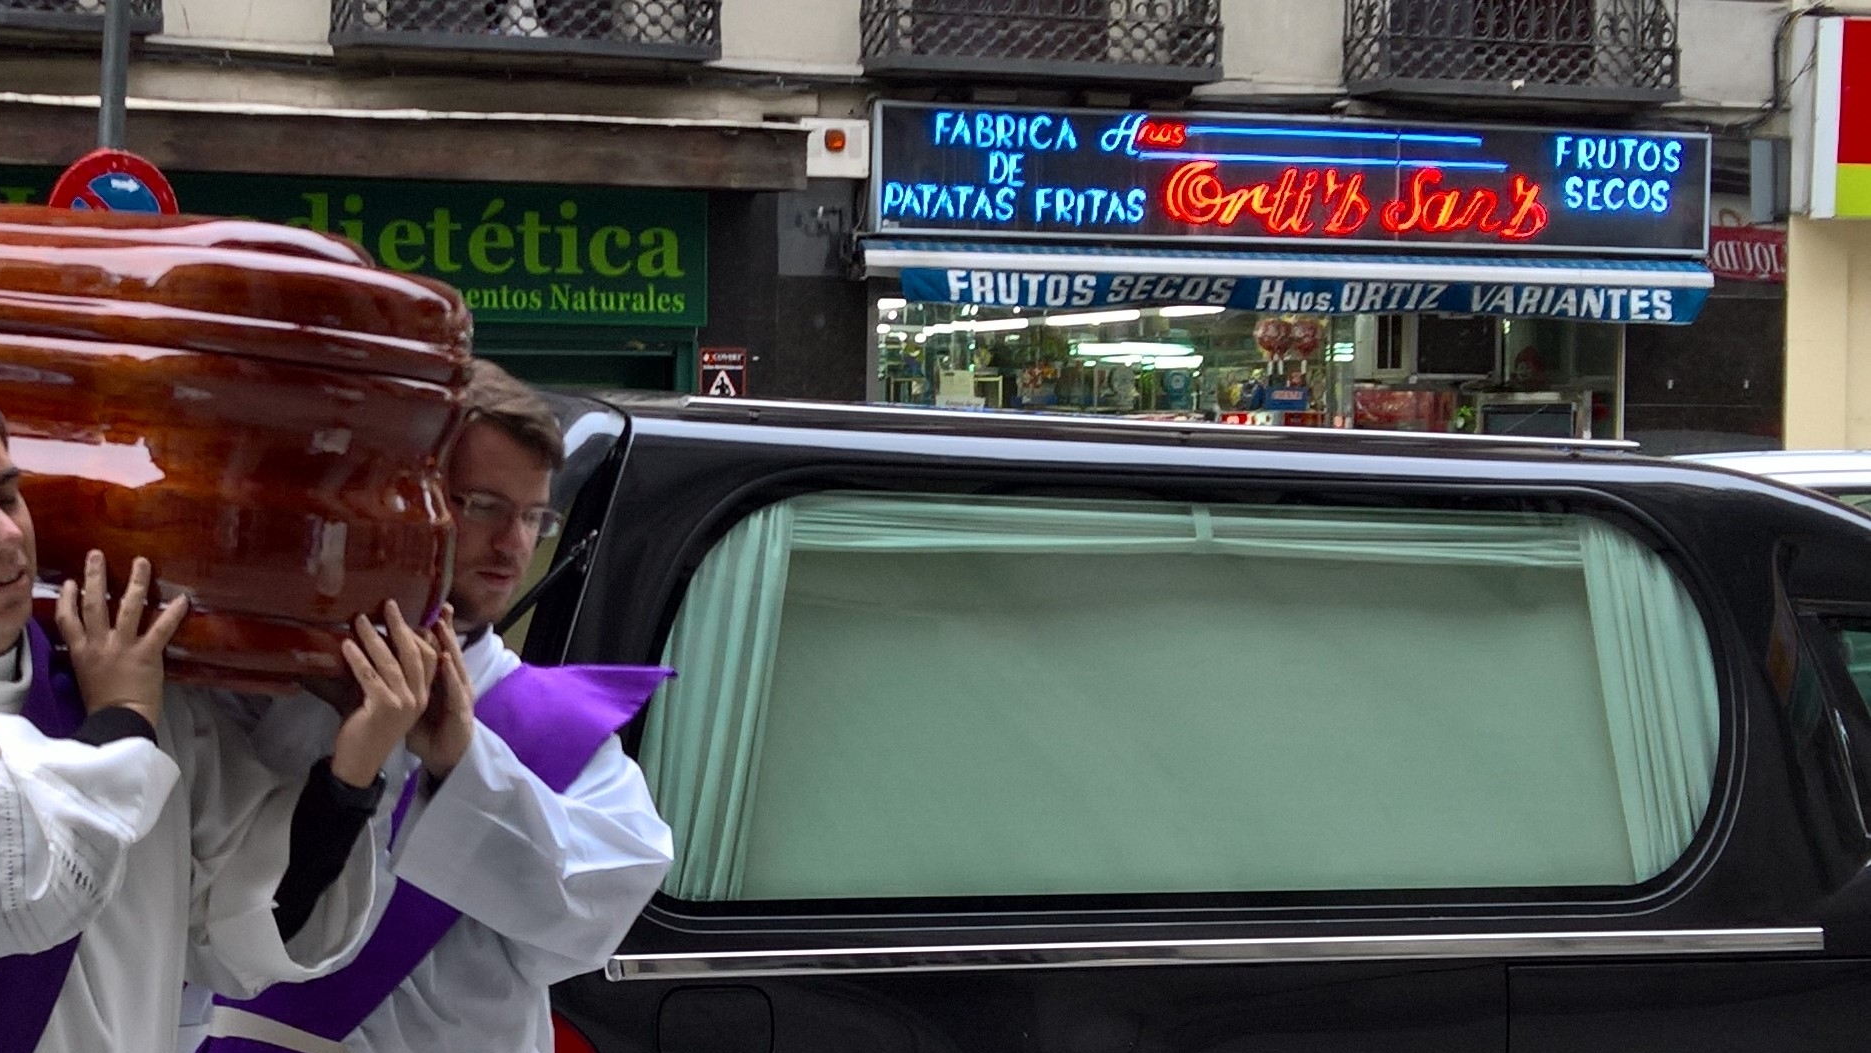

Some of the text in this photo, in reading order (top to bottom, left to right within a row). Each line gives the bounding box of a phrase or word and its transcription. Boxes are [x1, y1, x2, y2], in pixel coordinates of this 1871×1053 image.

[934, 110, 1078, 152] FABRICA
[987, 151, 1027, 188] DE
[1554, 134, 1683, 174] FRUTOS
[882, 181, 1148, 226] PATATAS FRITAS
[1564, 175, 1671, 213] SECOS
[465, 284, 686, 314] entos Naturales
[945, 268, 1097, 307] FRUTOS
[1108, 274, 1235, 305] SECOS
[1338, 281, 1449, 312] ORTIZ
[1469, 284, 1674, 322] VARIANTES
